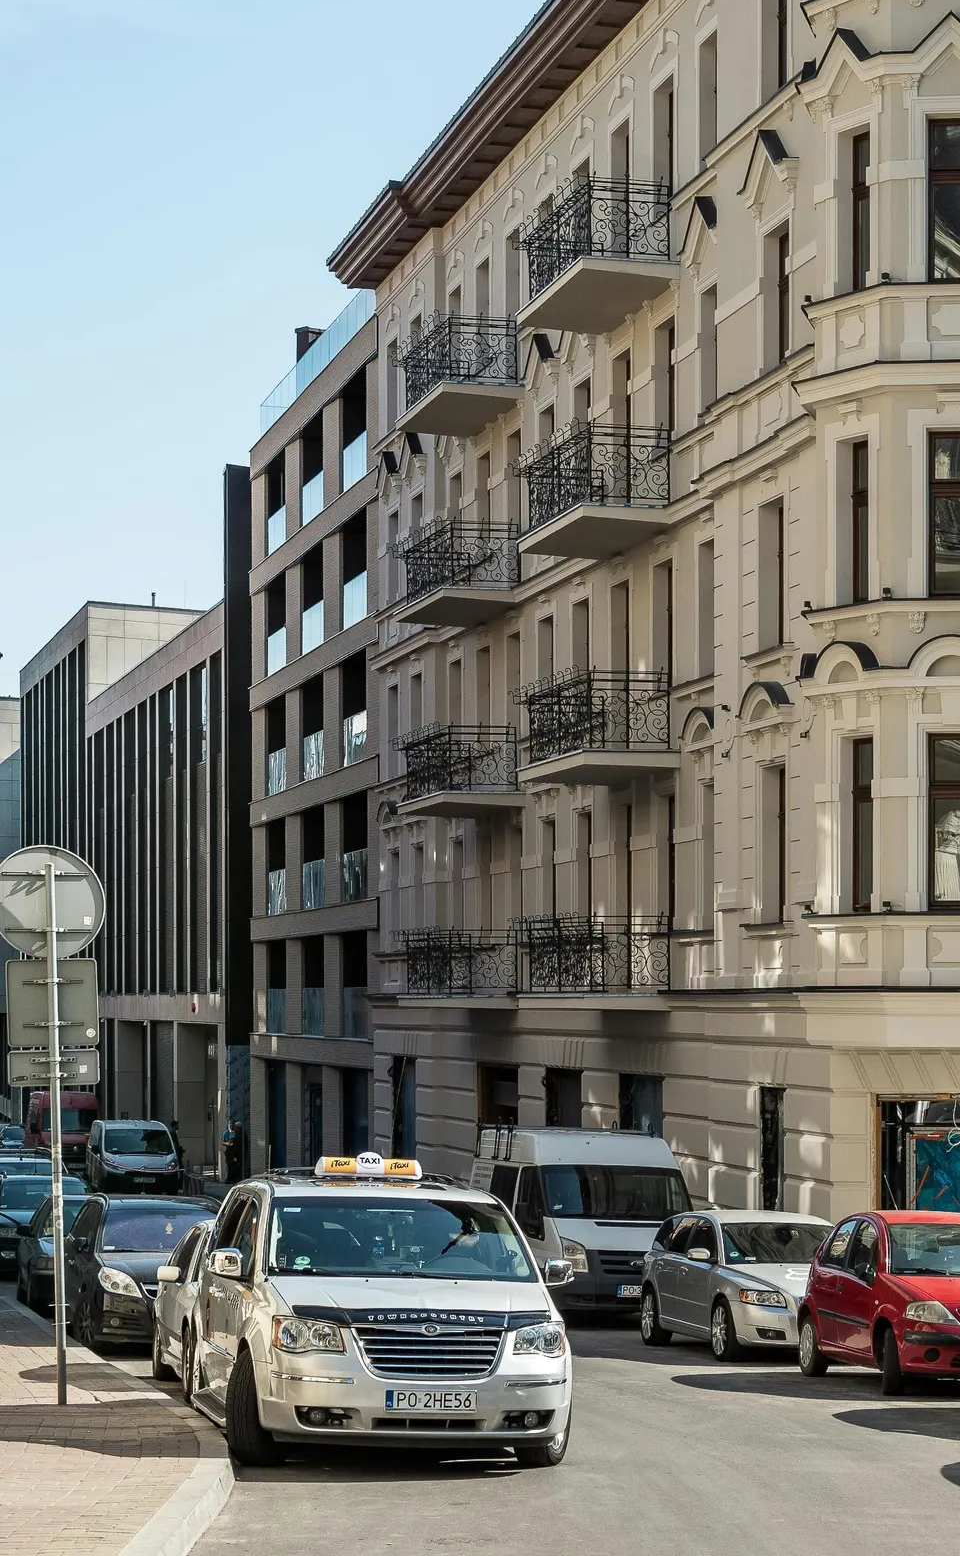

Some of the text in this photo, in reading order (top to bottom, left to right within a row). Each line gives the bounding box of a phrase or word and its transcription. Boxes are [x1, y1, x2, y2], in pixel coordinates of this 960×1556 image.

[623, 1286, 635, 1294] PO
[396, 1392, 472, 1408] PO 2HE56
